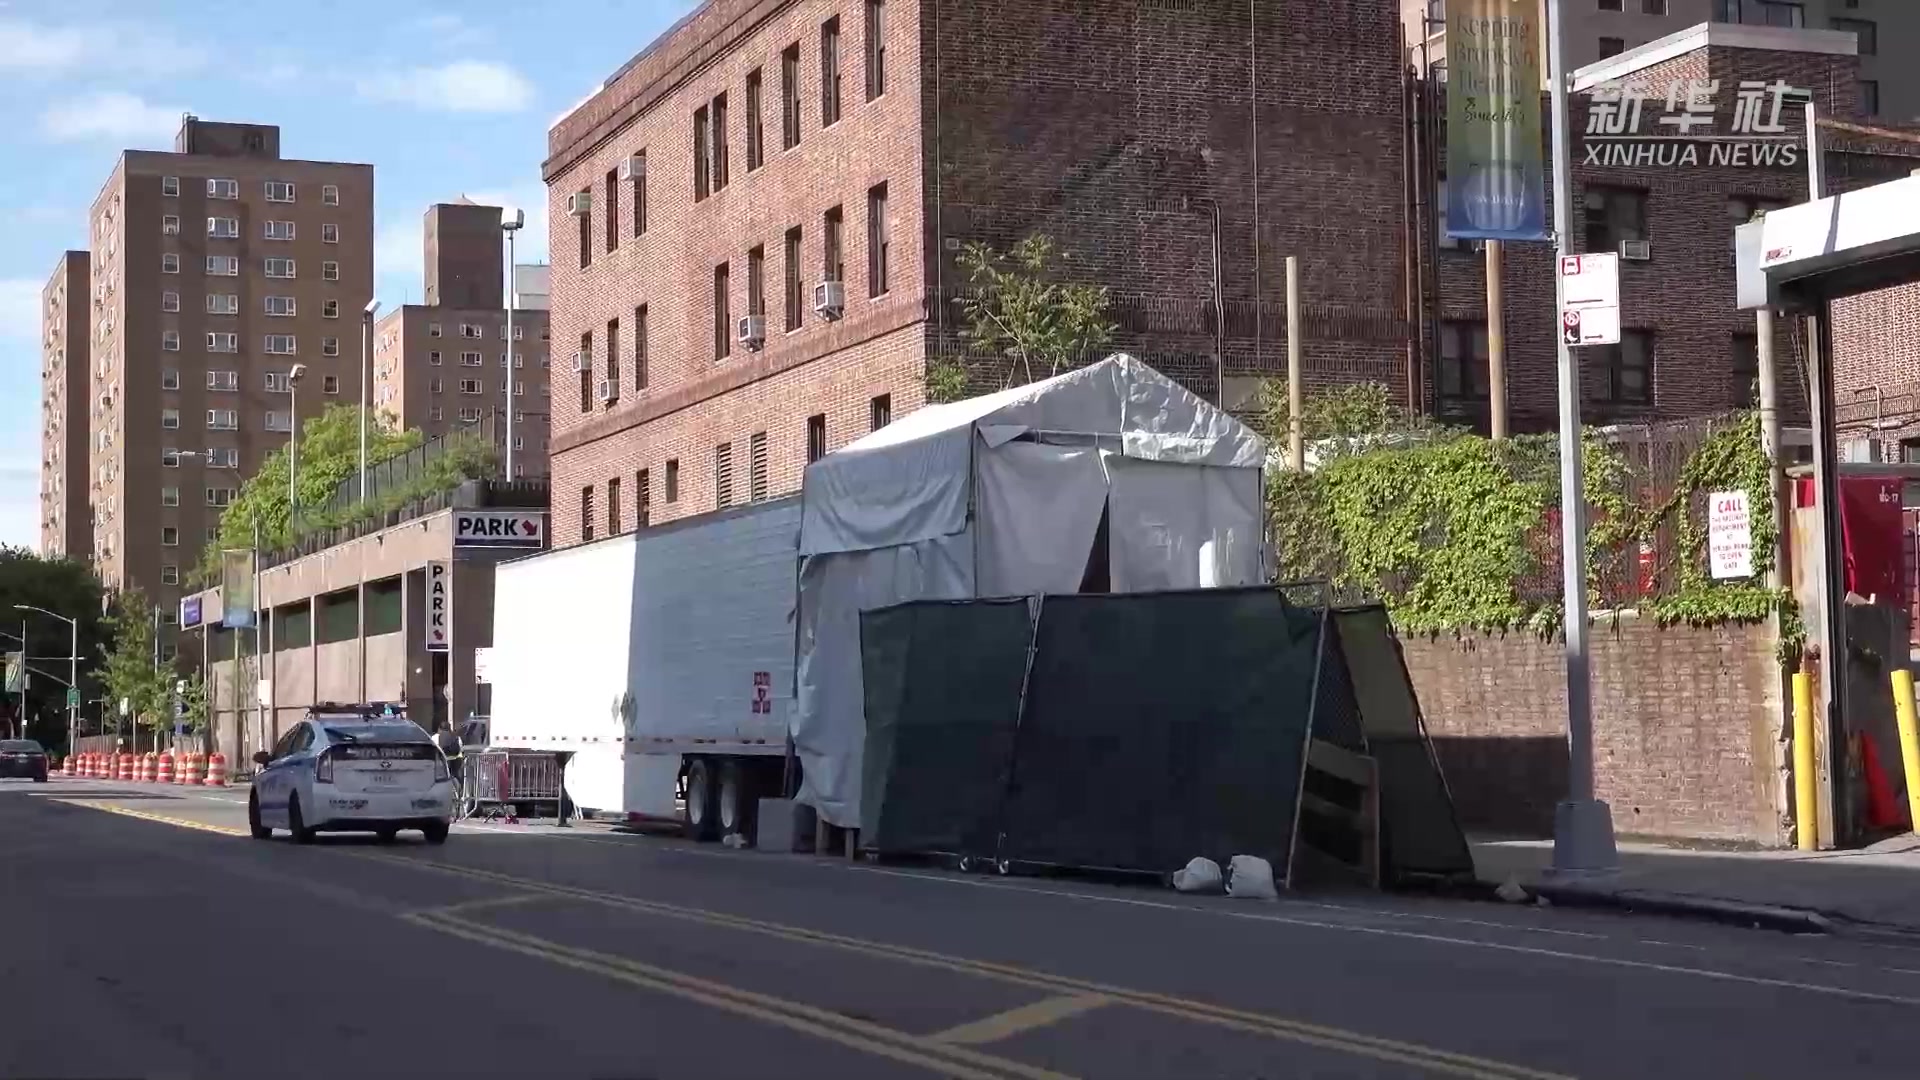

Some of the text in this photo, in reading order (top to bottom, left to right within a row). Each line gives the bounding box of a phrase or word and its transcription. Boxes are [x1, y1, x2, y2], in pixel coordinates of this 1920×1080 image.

[1457, 16, 1530, 41] Keeping
[1454, 41, 1534, 68] Brooklyn
[1718, 498, 1742, 513] CALL
[458, 517, 518, 536] PARK
[432, 565, 445, 627] PARK
